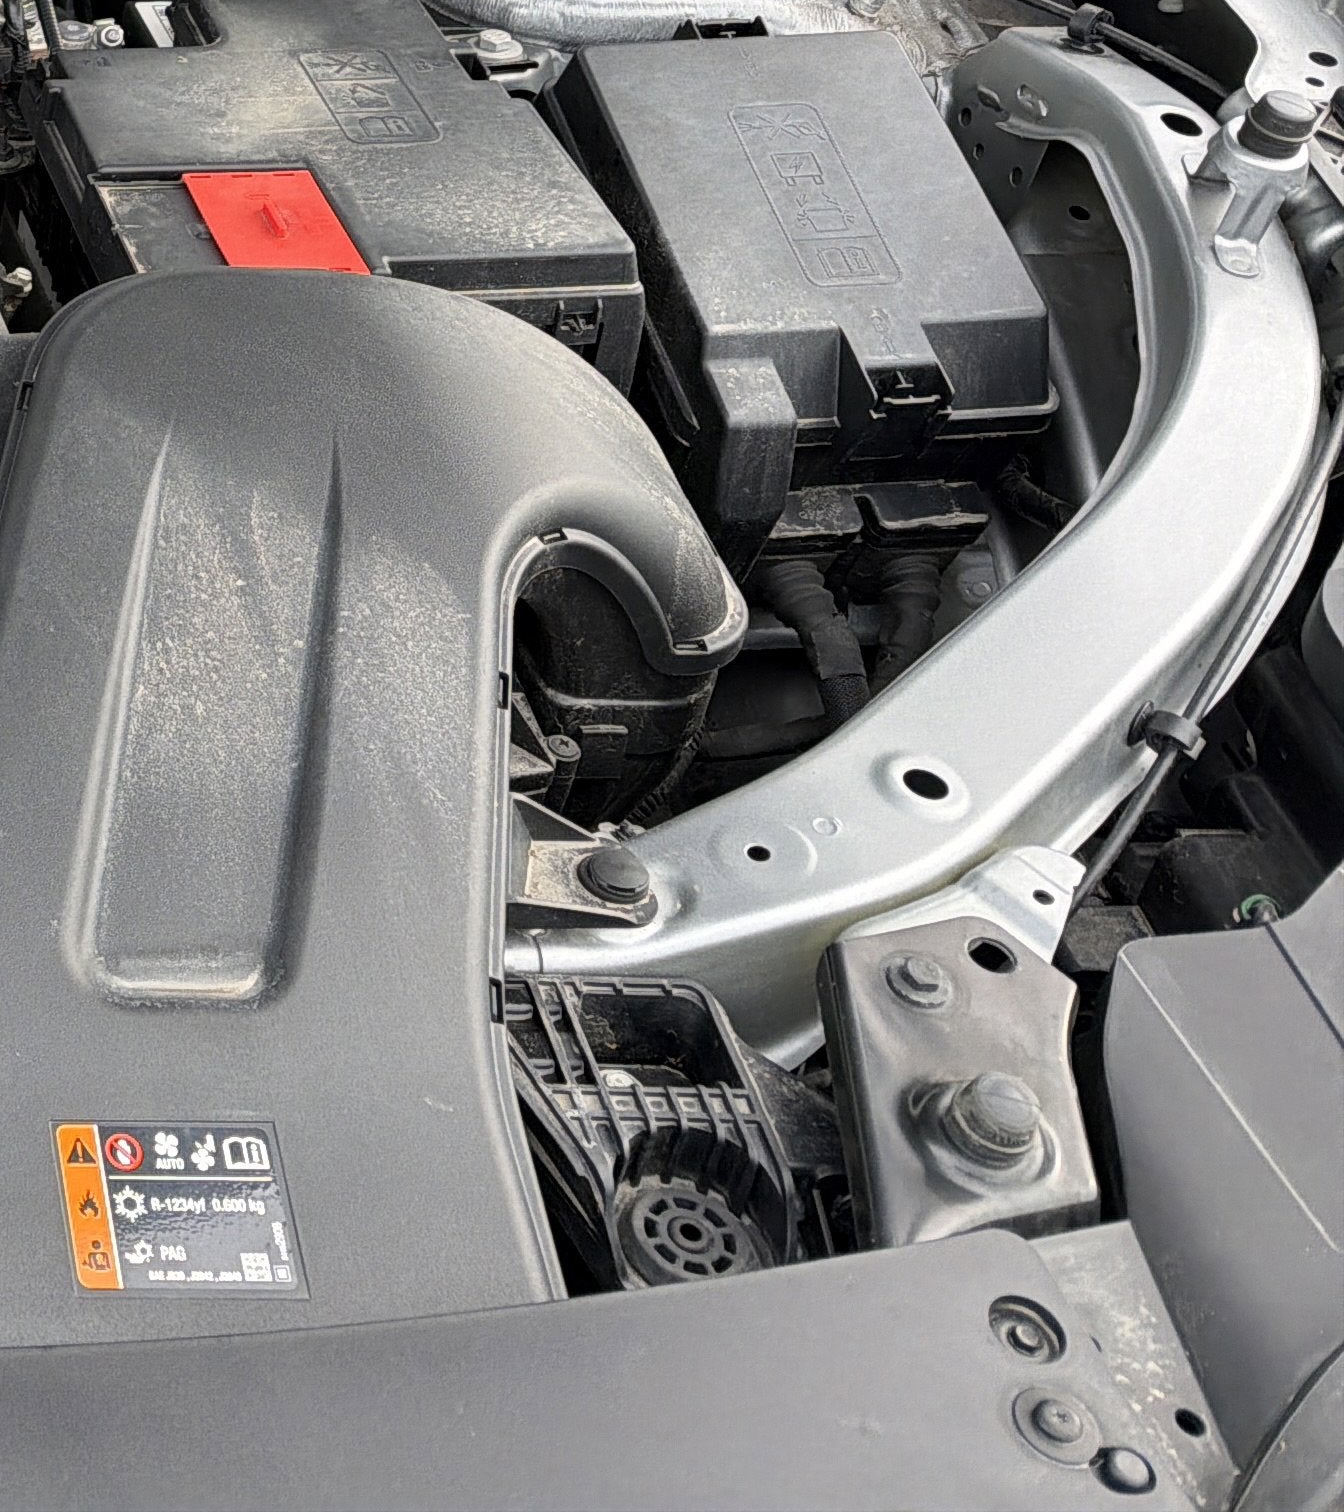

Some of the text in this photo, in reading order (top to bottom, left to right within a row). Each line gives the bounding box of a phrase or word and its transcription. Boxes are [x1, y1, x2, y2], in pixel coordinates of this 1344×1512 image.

[156, 1157, 185, 1170] AUTO
[150, 1197, 207, 1215] R-1234yf
[248, 1197, 266, 1216] kg
[160, 1245, 187, 1262] PAG
